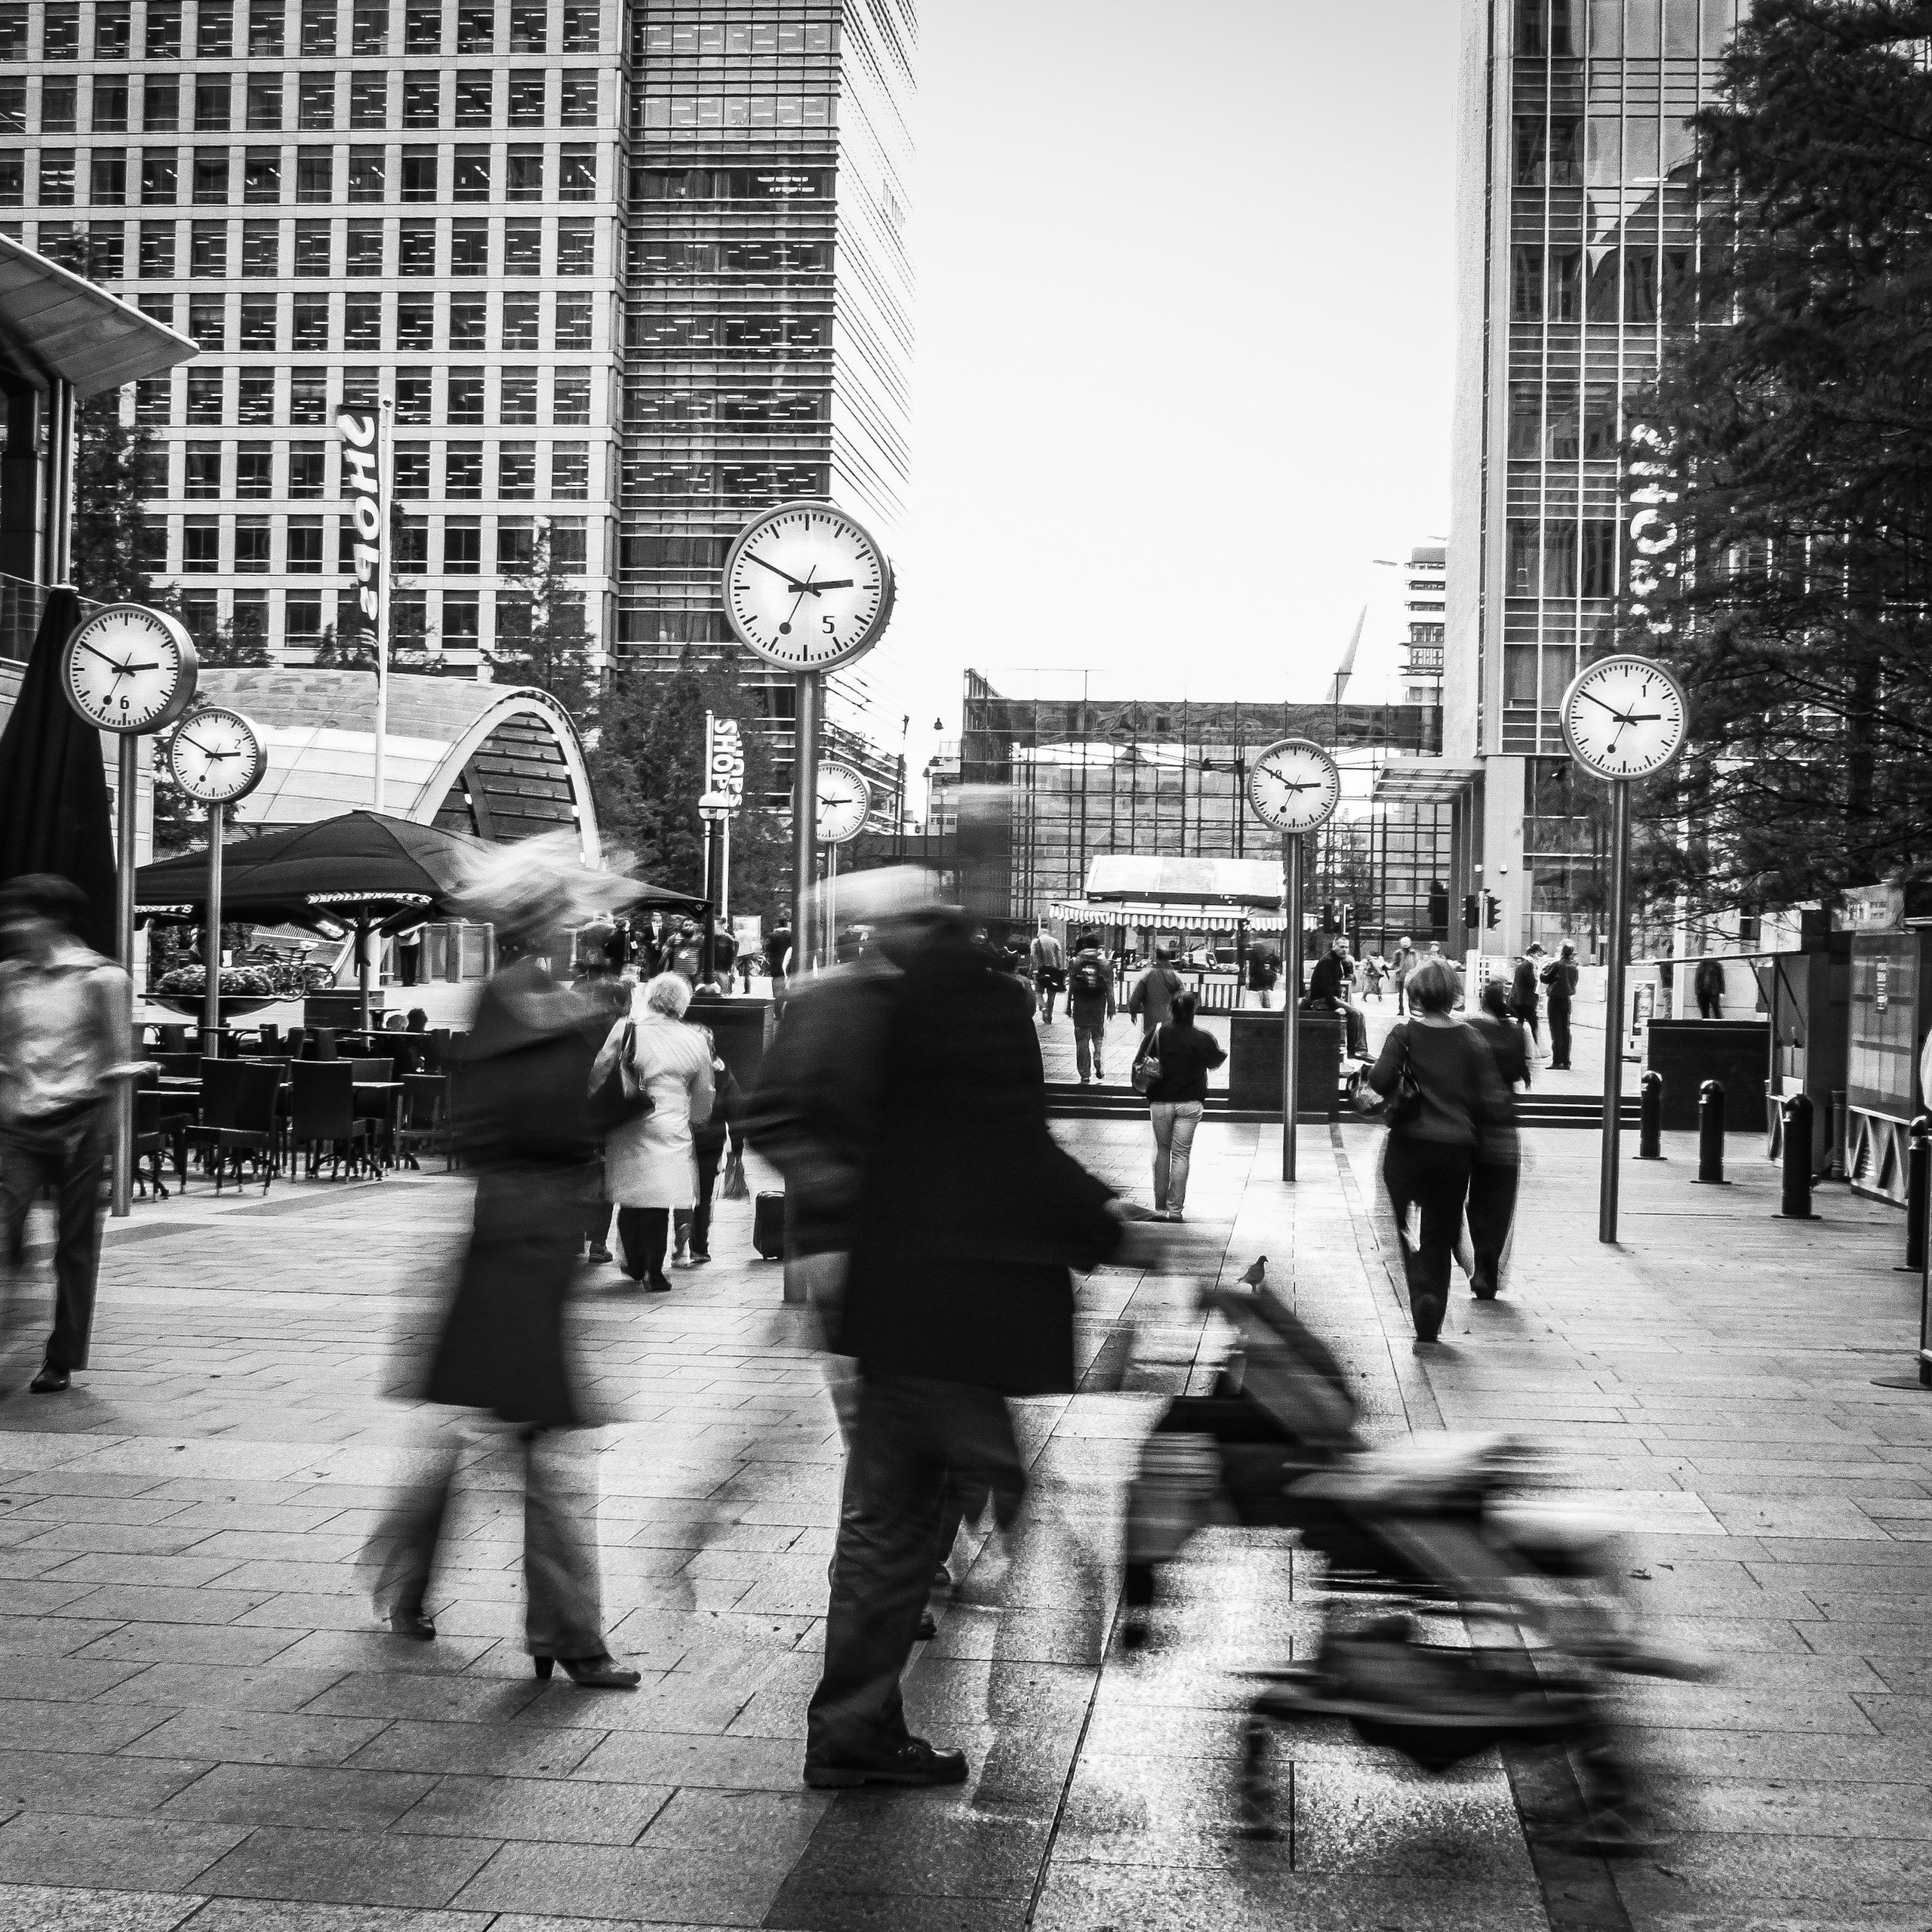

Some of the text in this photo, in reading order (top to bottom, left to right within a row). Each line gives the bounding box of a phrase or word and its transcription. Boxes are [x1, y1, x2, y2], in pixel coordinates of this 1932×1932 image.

[822, 615, 836, 634] 5
[1641, 685, 1647, 698] 1
[120, 695, 130, 709] 6
[234, 739, 242, 749] 2
[712, 719, 738, 799] SHOP
[1269, 769, 1282, 780] 10
